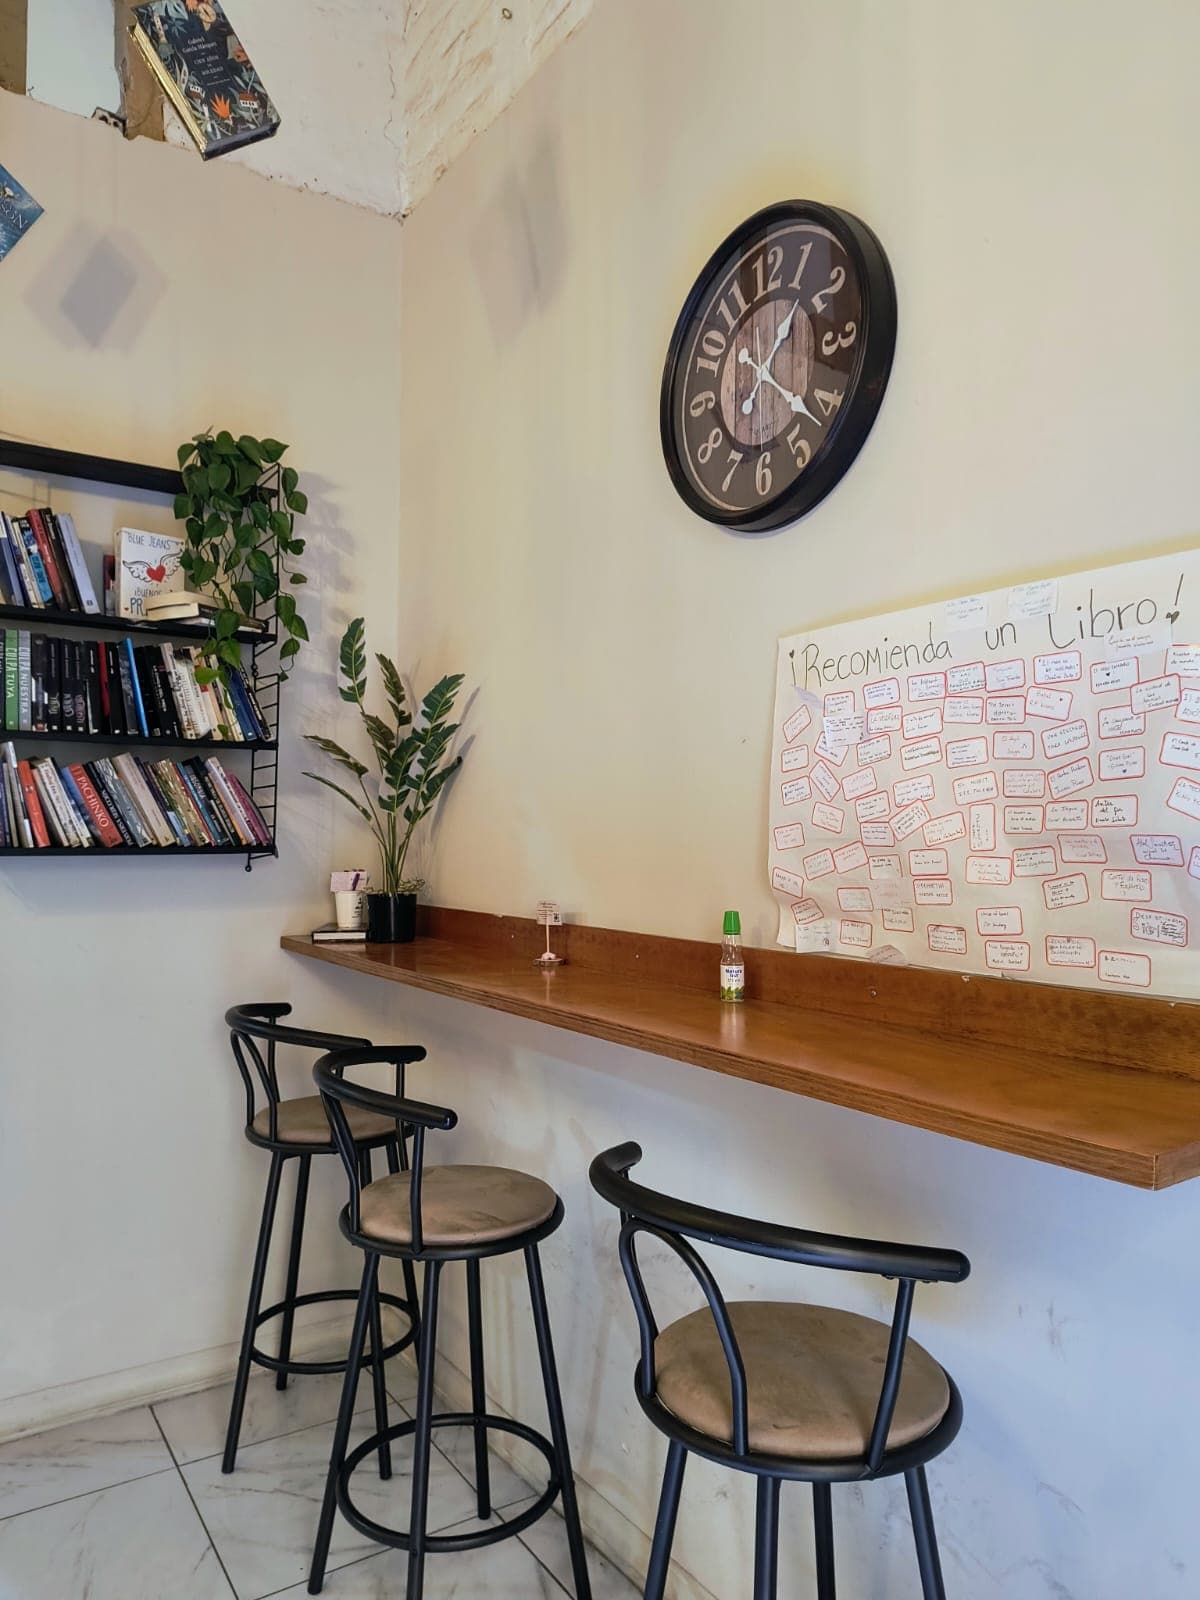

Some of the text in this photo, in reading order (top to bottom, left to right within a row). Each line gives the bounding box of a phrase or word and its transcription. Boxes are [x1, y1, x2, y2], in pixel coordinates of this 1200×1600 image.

[751, 246, 784, 301] 12
[788, 241, 813, 291] 1
[716, 283, 752, 336] 11
[811, 266, 847, 315] 2
[696, 330, 727, 378] 10
[821, 321, 857, 356] 3
[689, 390, 716, 418] 9
[813, 387, 845, 417] 4
[698, 427, 723, 464] 8
[787, 423, 812, 469] 5
[721, 449, 744, 492] 7
[755, 451, 773, 496] 6
[127, 532, 171, 551] BLUE JEANS
[985, 622, 1017, 651] un
[1048, 573, 1184, 650] Libro!
[6, 647, 18, 698] CULPA TUYA
[20, 672, 29, 714] NUESTRA
[79, 776, 110, 828] PACHINKO
